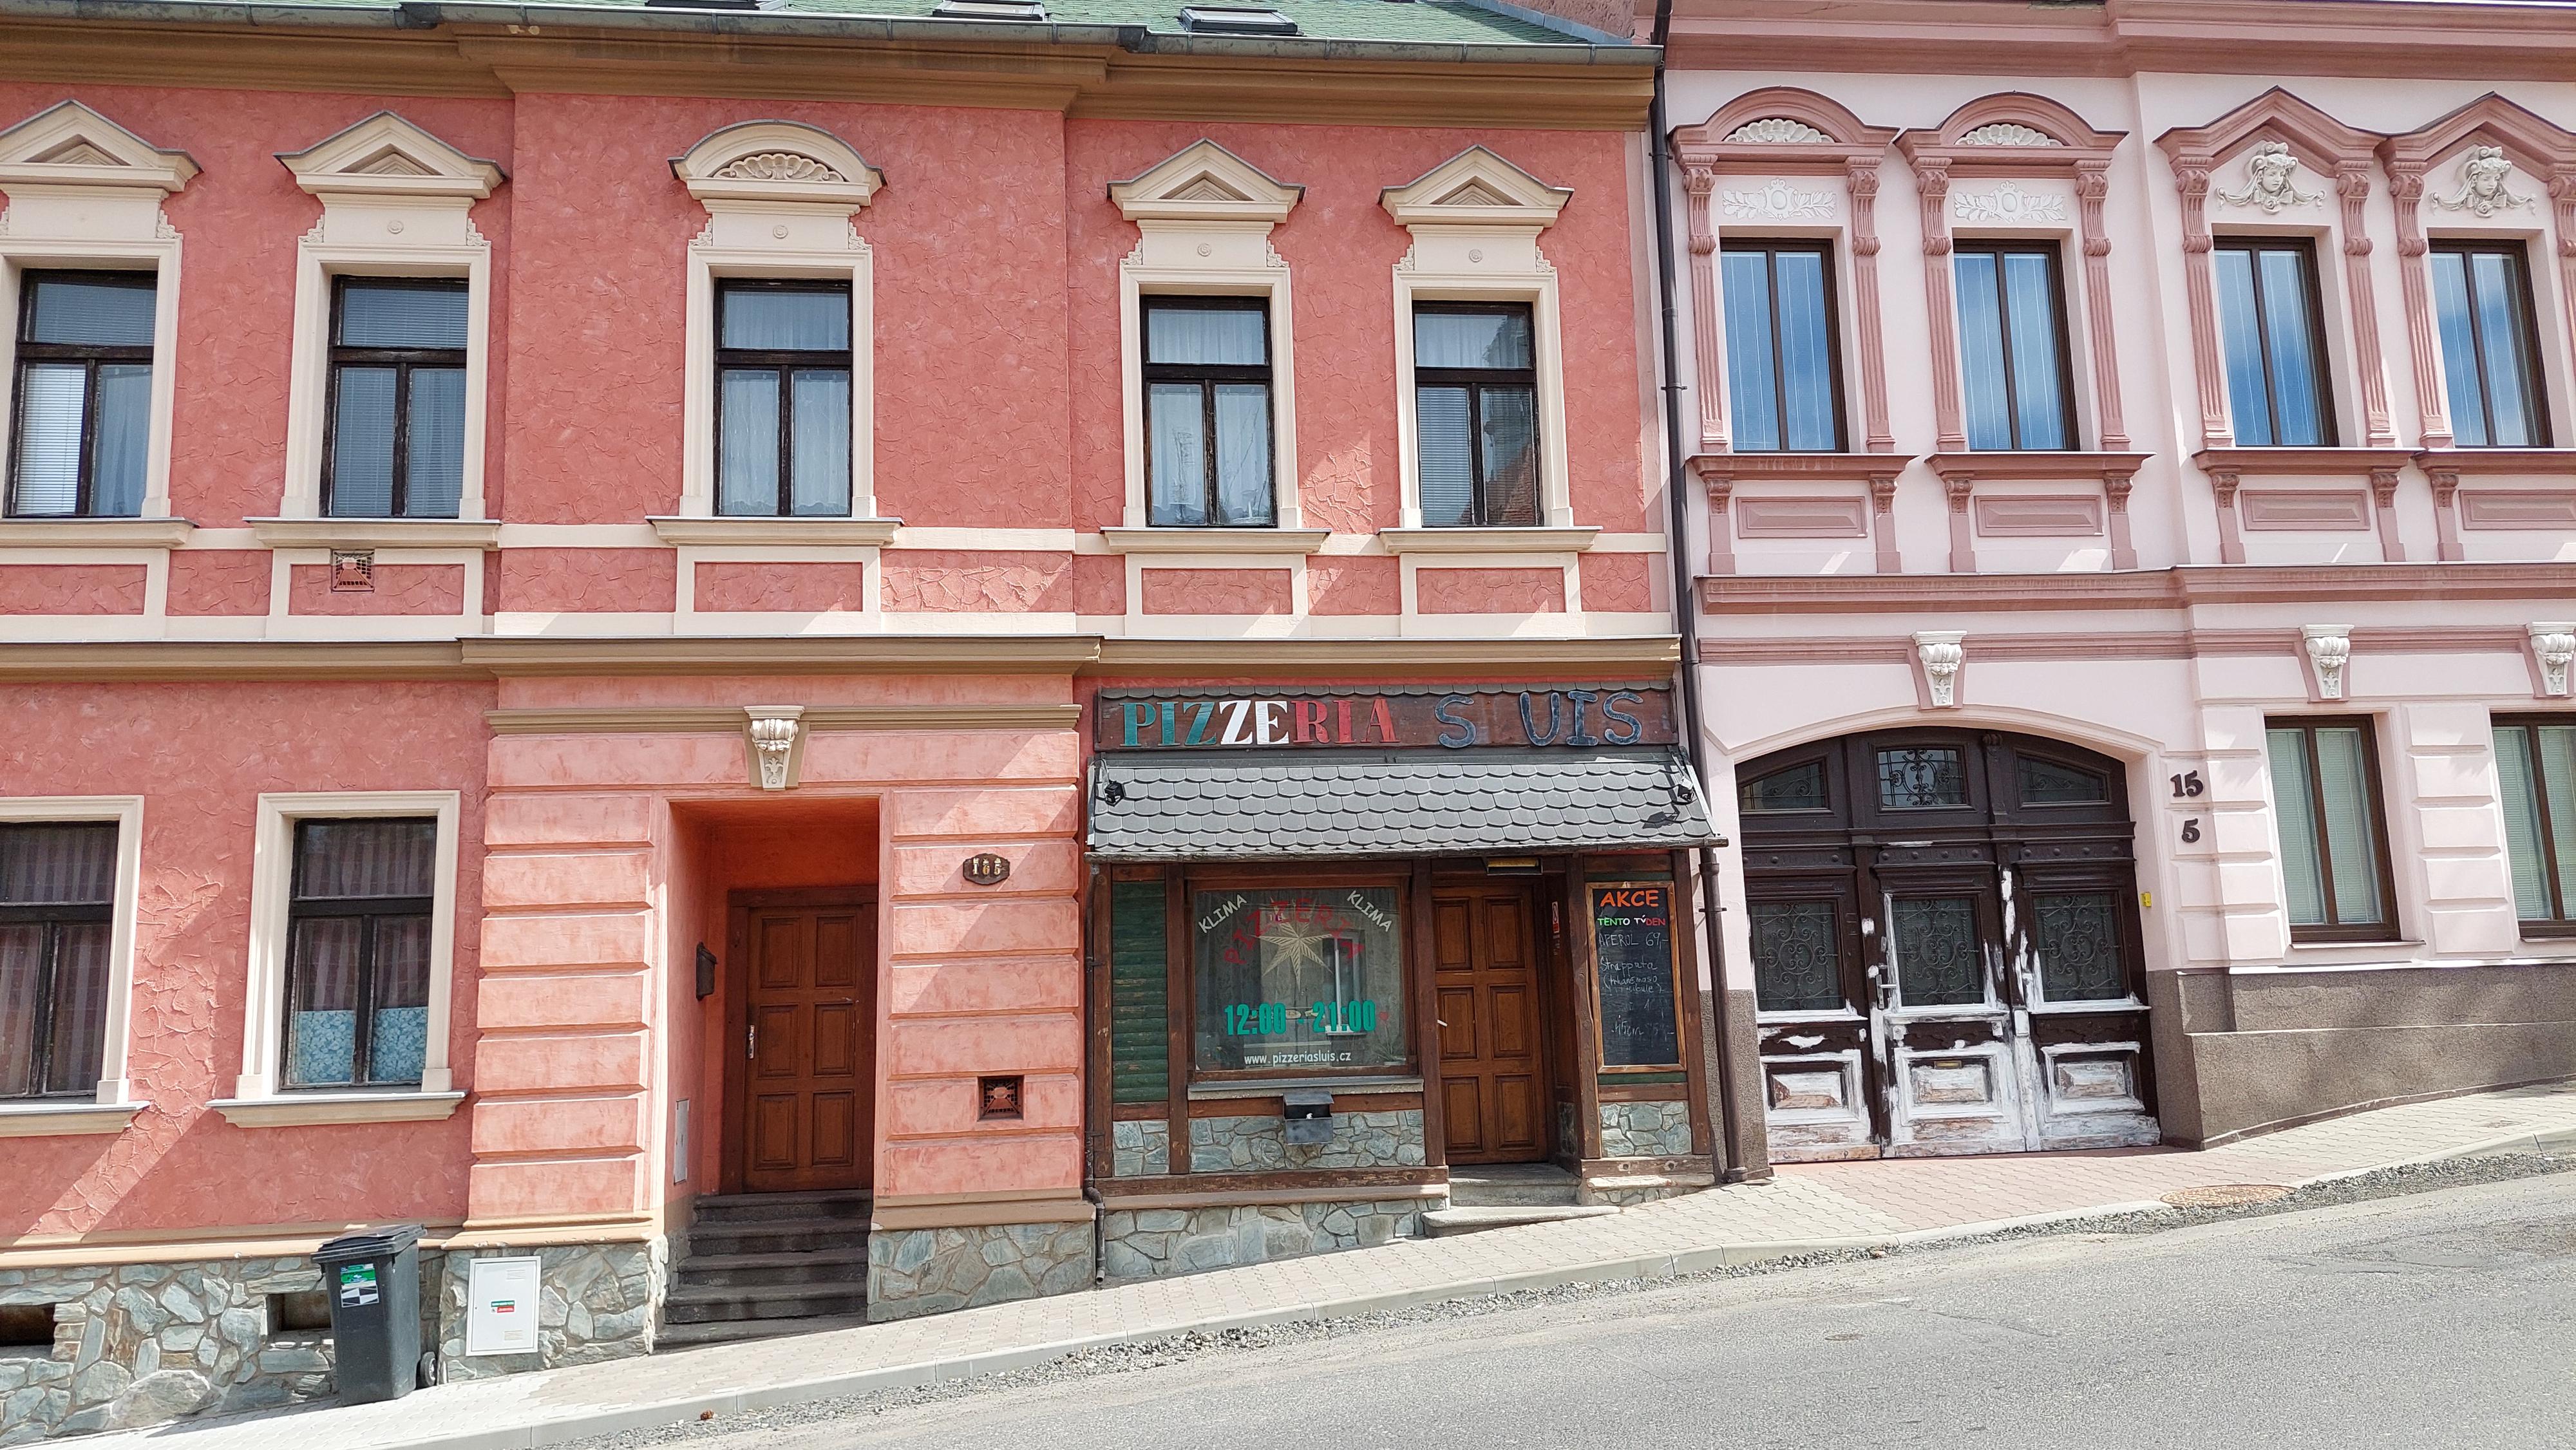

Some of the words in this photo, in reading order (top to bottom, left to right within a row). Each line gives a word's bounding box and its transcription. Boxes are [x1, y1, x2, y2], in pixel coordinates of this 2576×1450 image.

[1119, 699, 1396, 747] PIZZERIA
[2170, 769, 2204, 797] 15
[2181, 818, 2201, 843] 5
[972, 862, 1001, 876] 165
[1347, 890, 1393, 932] KLIMA
[1600, 890, 1659, 907] AKCE
[1198, 894, 1247, 934] KLIMA
[1597, 918, 1630, 926] TENTO
[1224, 898, 1365, 965] PIZZERIA
[1598, 932, 1639, 947] APEROL
[1224, 1003, 1286, 1037] 12:00
[1312, 999, 1376, 1033] 21:00
[1244, 1050, 1351, 1067] www.pizzeriasluis.cz
